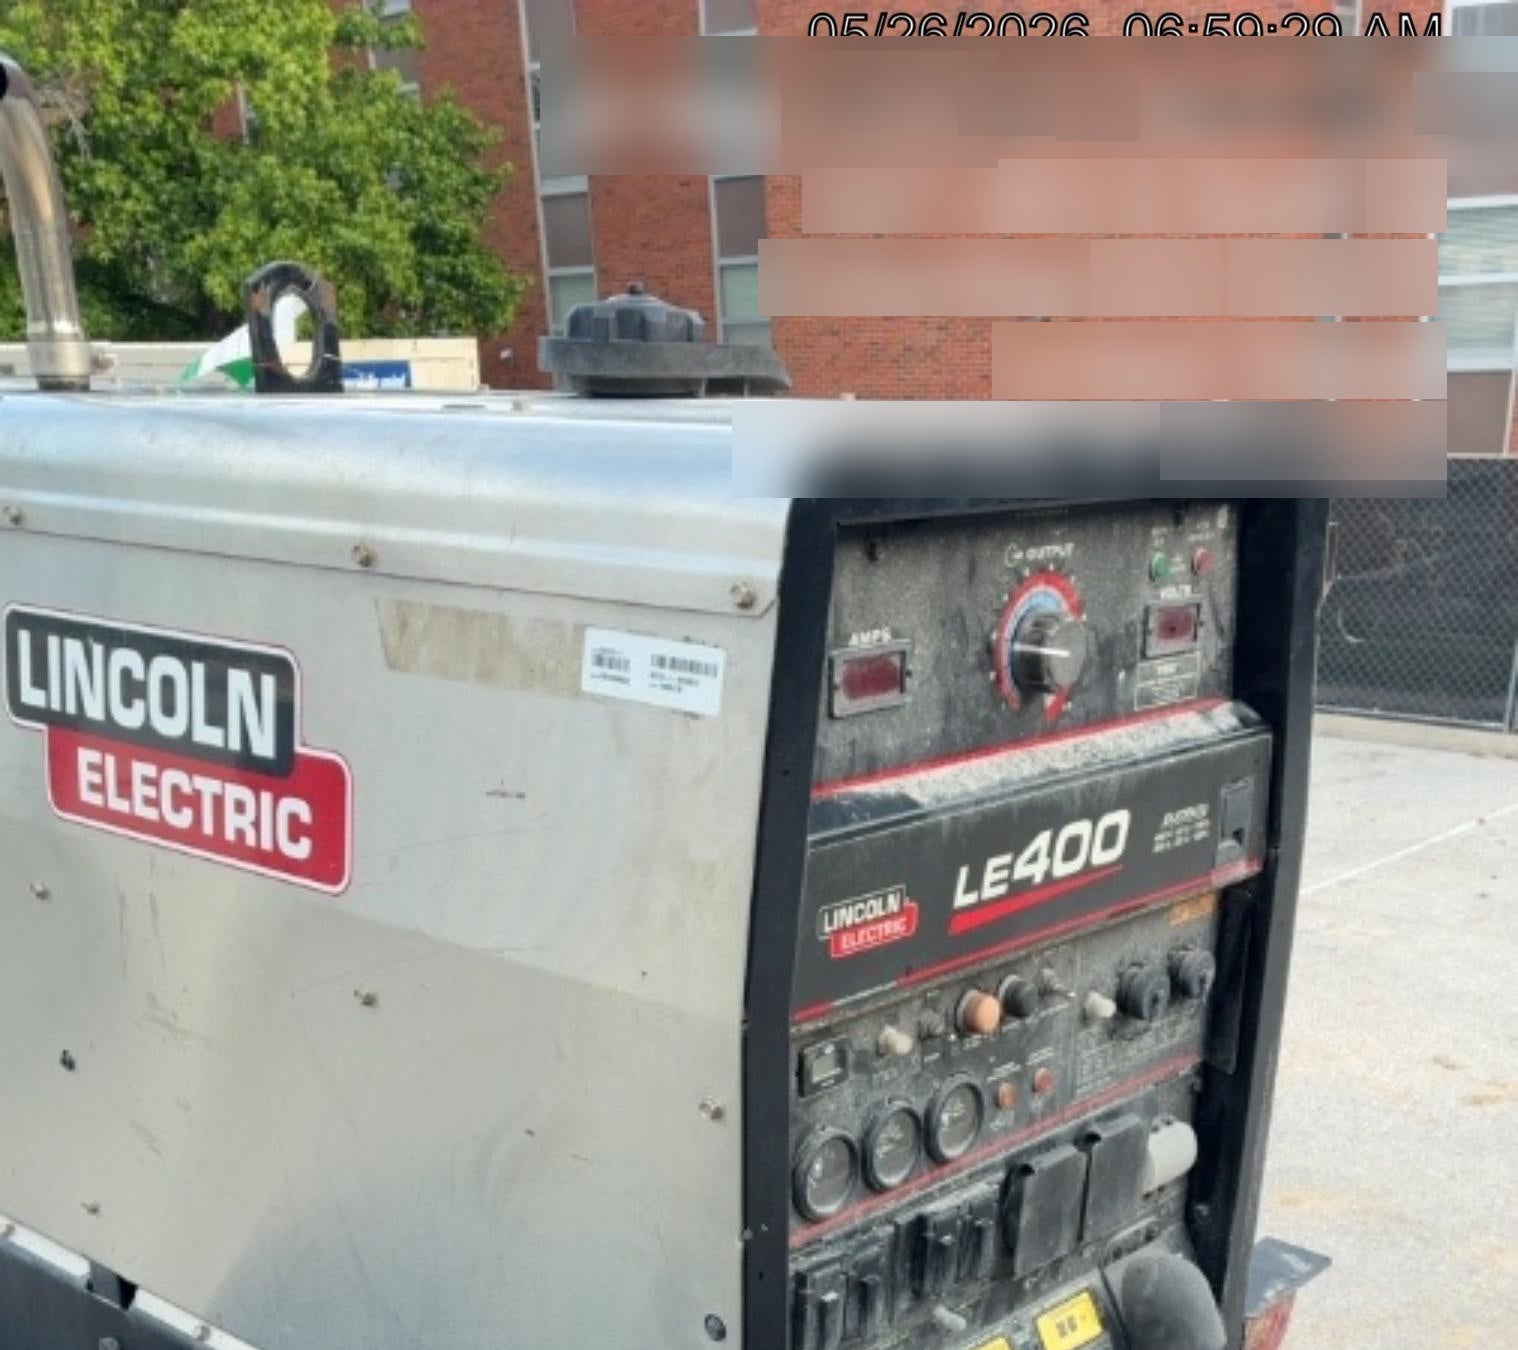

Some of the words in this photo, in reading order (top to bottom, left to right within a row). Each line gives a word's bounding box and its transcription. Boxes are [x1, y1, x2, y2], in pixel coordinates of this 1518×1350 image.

[1025, 542, 1075, 561] OUTPUT
[848, 627, 892, 647] AMPS
[17, 629, 277, 759] LINCOLN
[76, 747, 313, 860] ELECTRIC
[953, 809, 1131, 910] LE400
[823, 890, 901, 931] LINCOLN
[841, 917, 907, 949] ELECTRIC
